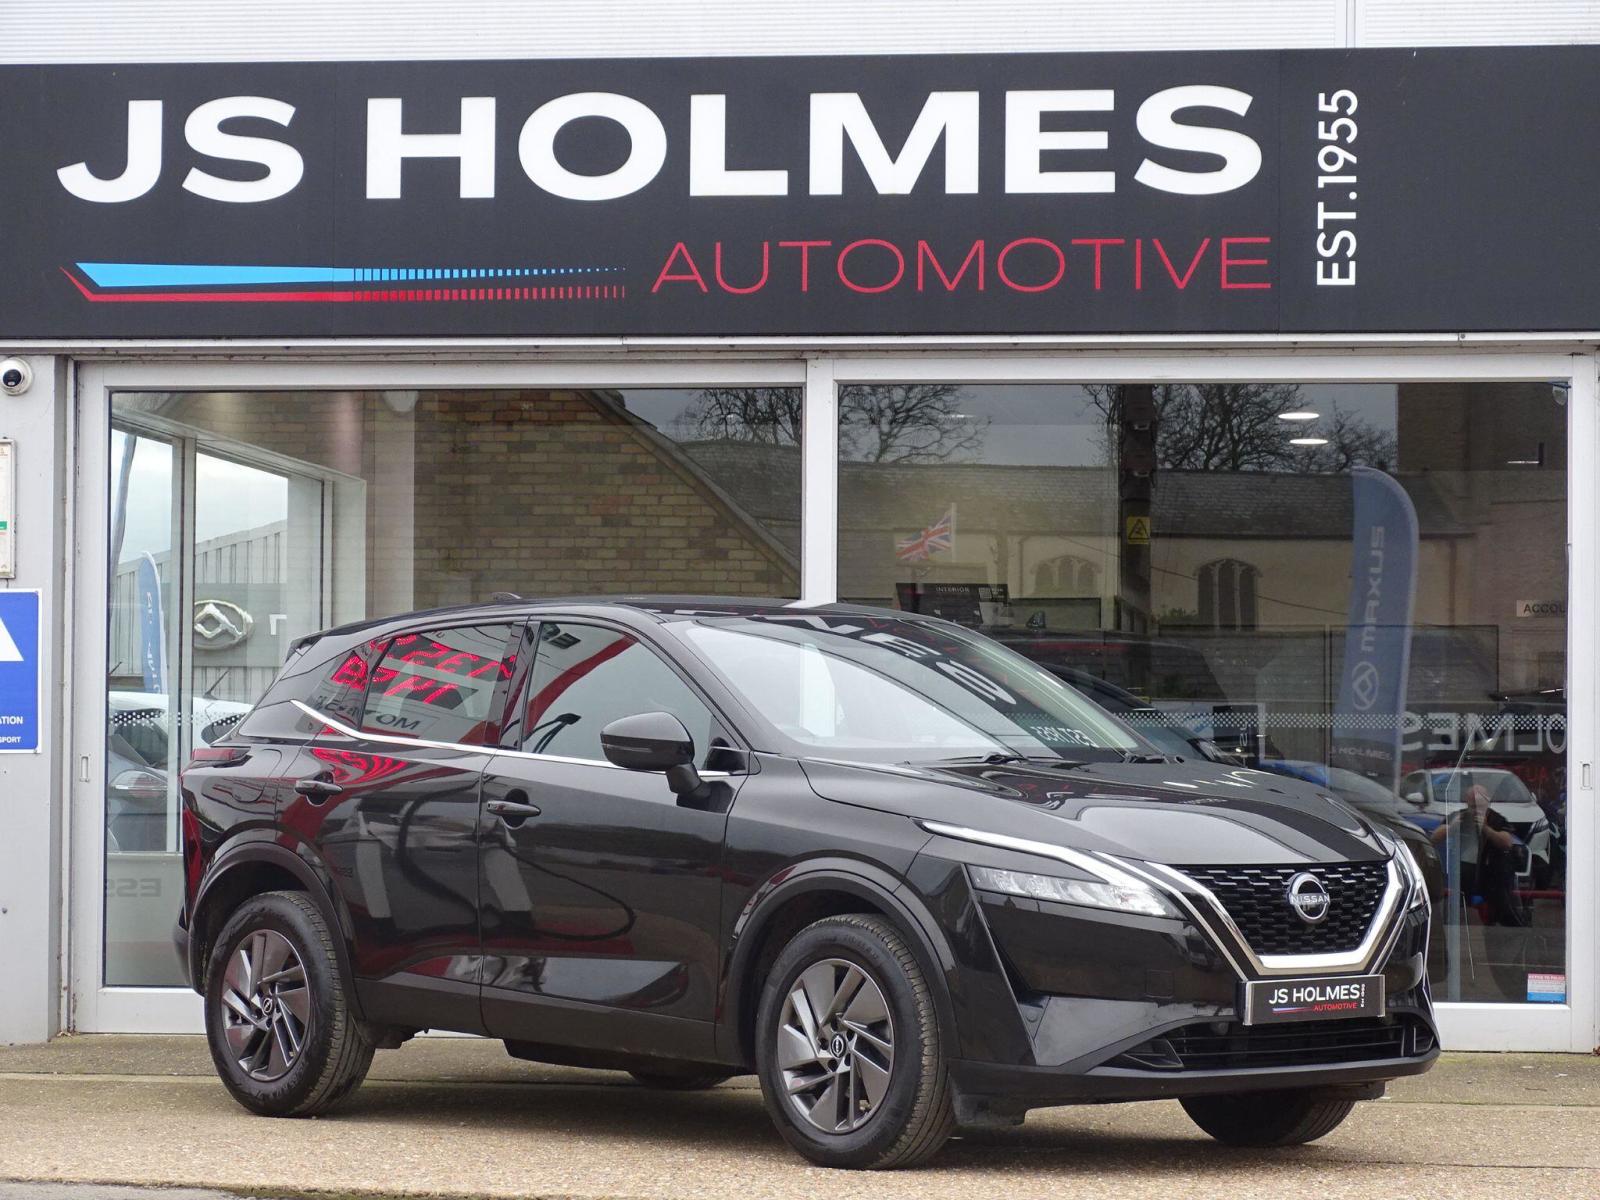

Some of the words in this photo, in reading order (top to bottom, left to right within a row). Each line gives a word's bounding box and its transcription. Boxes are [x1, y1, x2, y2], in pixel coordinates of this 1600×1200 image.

[57, 96, 304, 203] JS
[366, 85, 1263, 201] HOLMES
[1317, 89, 1358, 286] EST.1955
[651, 236, 1272, 294] AUTOMOTIVE
[1290, 894, 1330, 904] NISSAN
[1269, 988, 1289, 1005] JS
[1293, 983, 1360, 1003] HOLMES
[1313, 1002, 1358, 1012] AUTOMOTIVE
